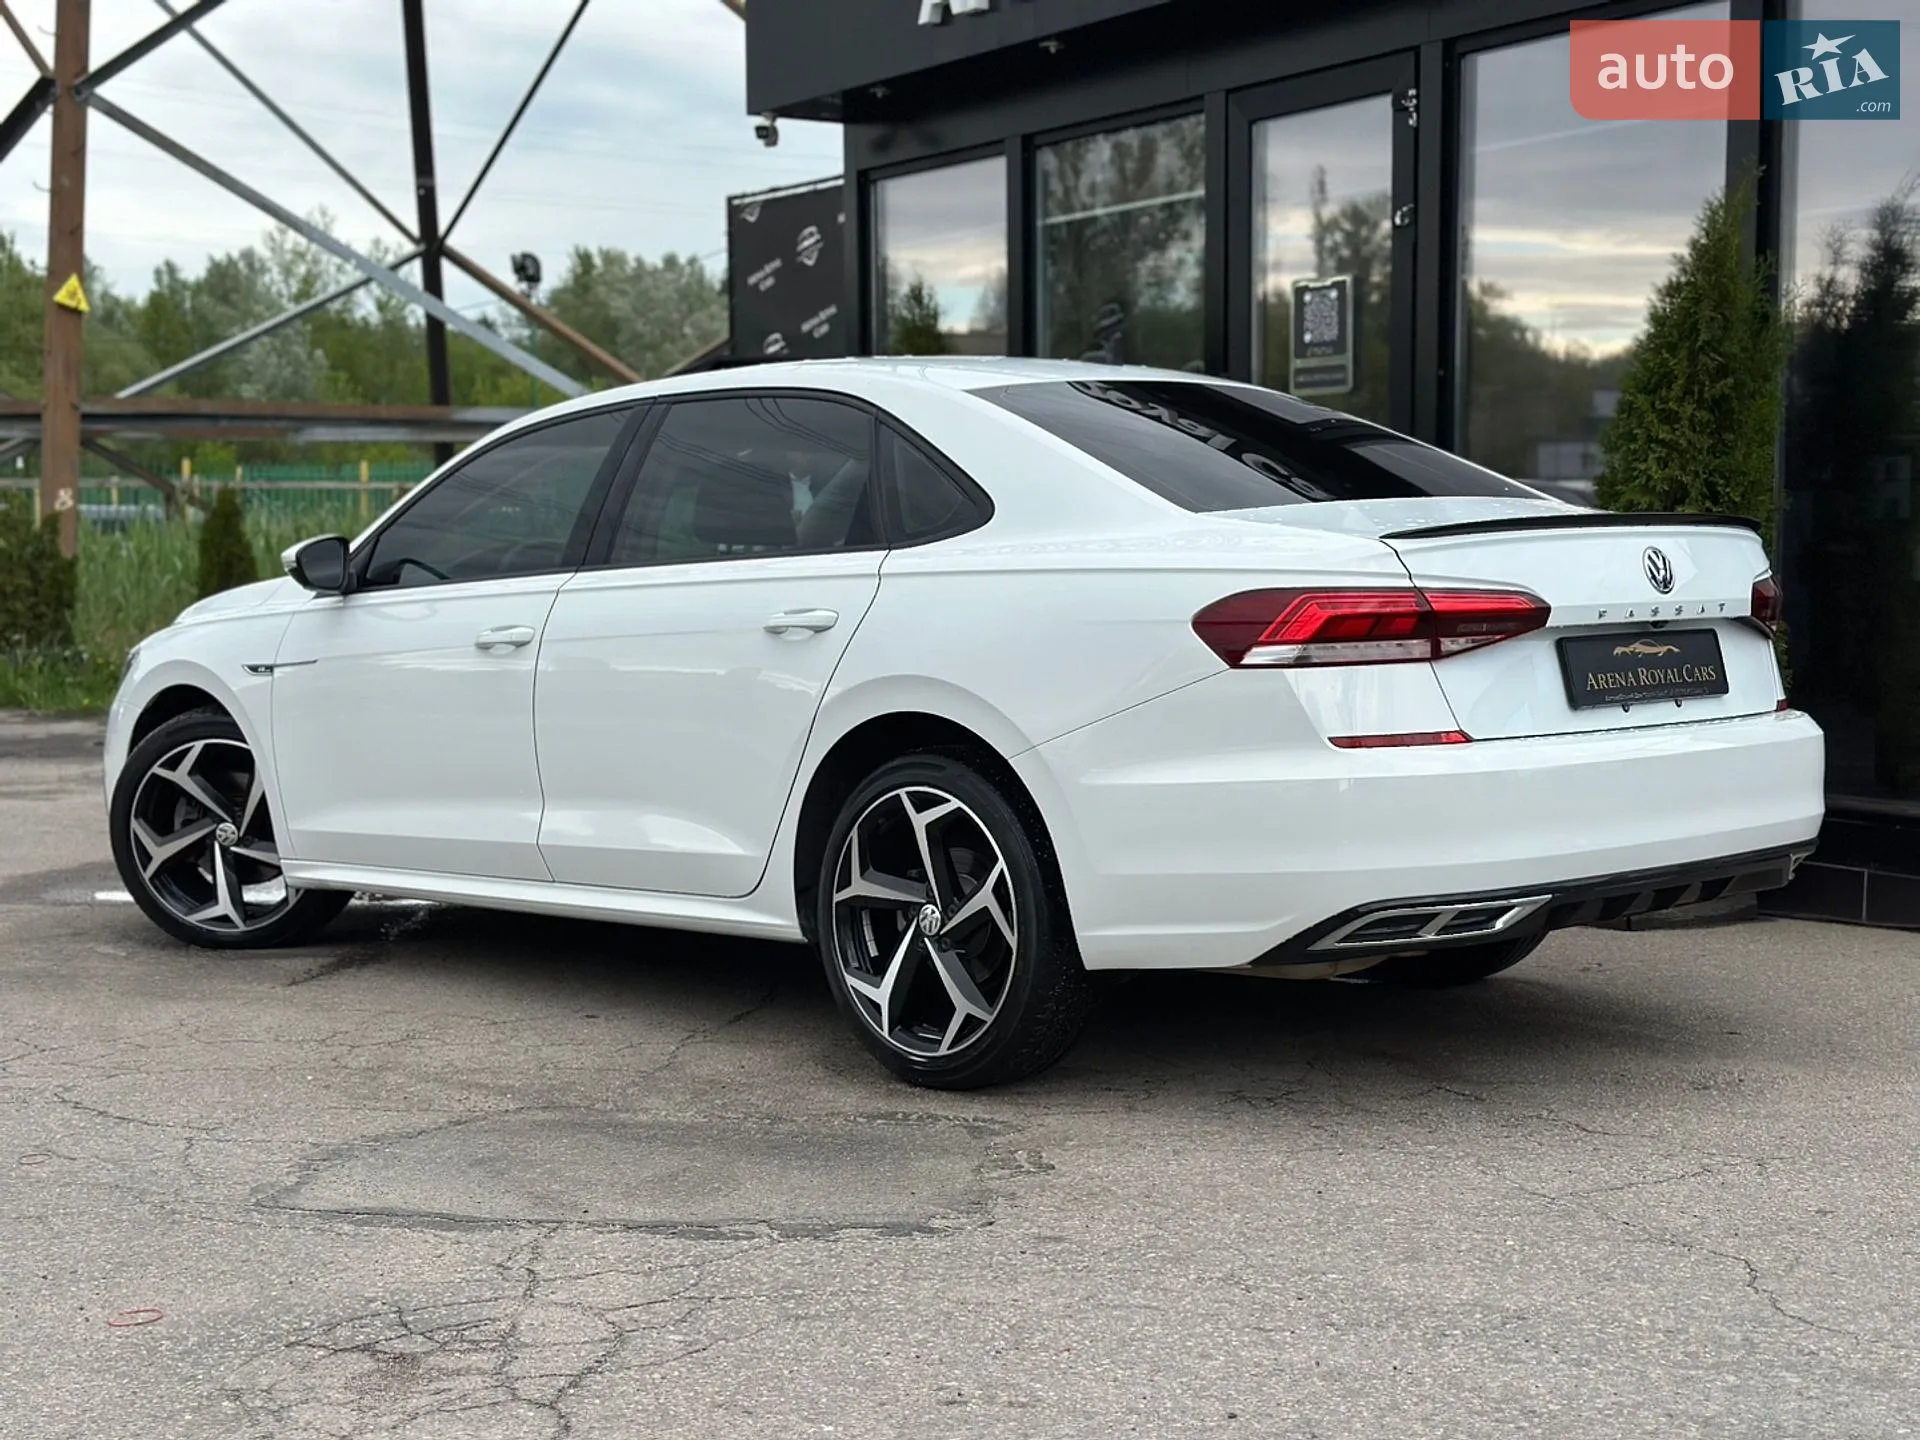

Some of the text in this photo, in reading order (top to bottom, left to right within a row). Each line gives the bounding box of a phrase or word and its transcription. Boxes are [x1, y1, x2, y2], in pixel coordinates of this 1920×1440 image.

[1586, 664, 1716, 691] ARENA ROYAL CARS
